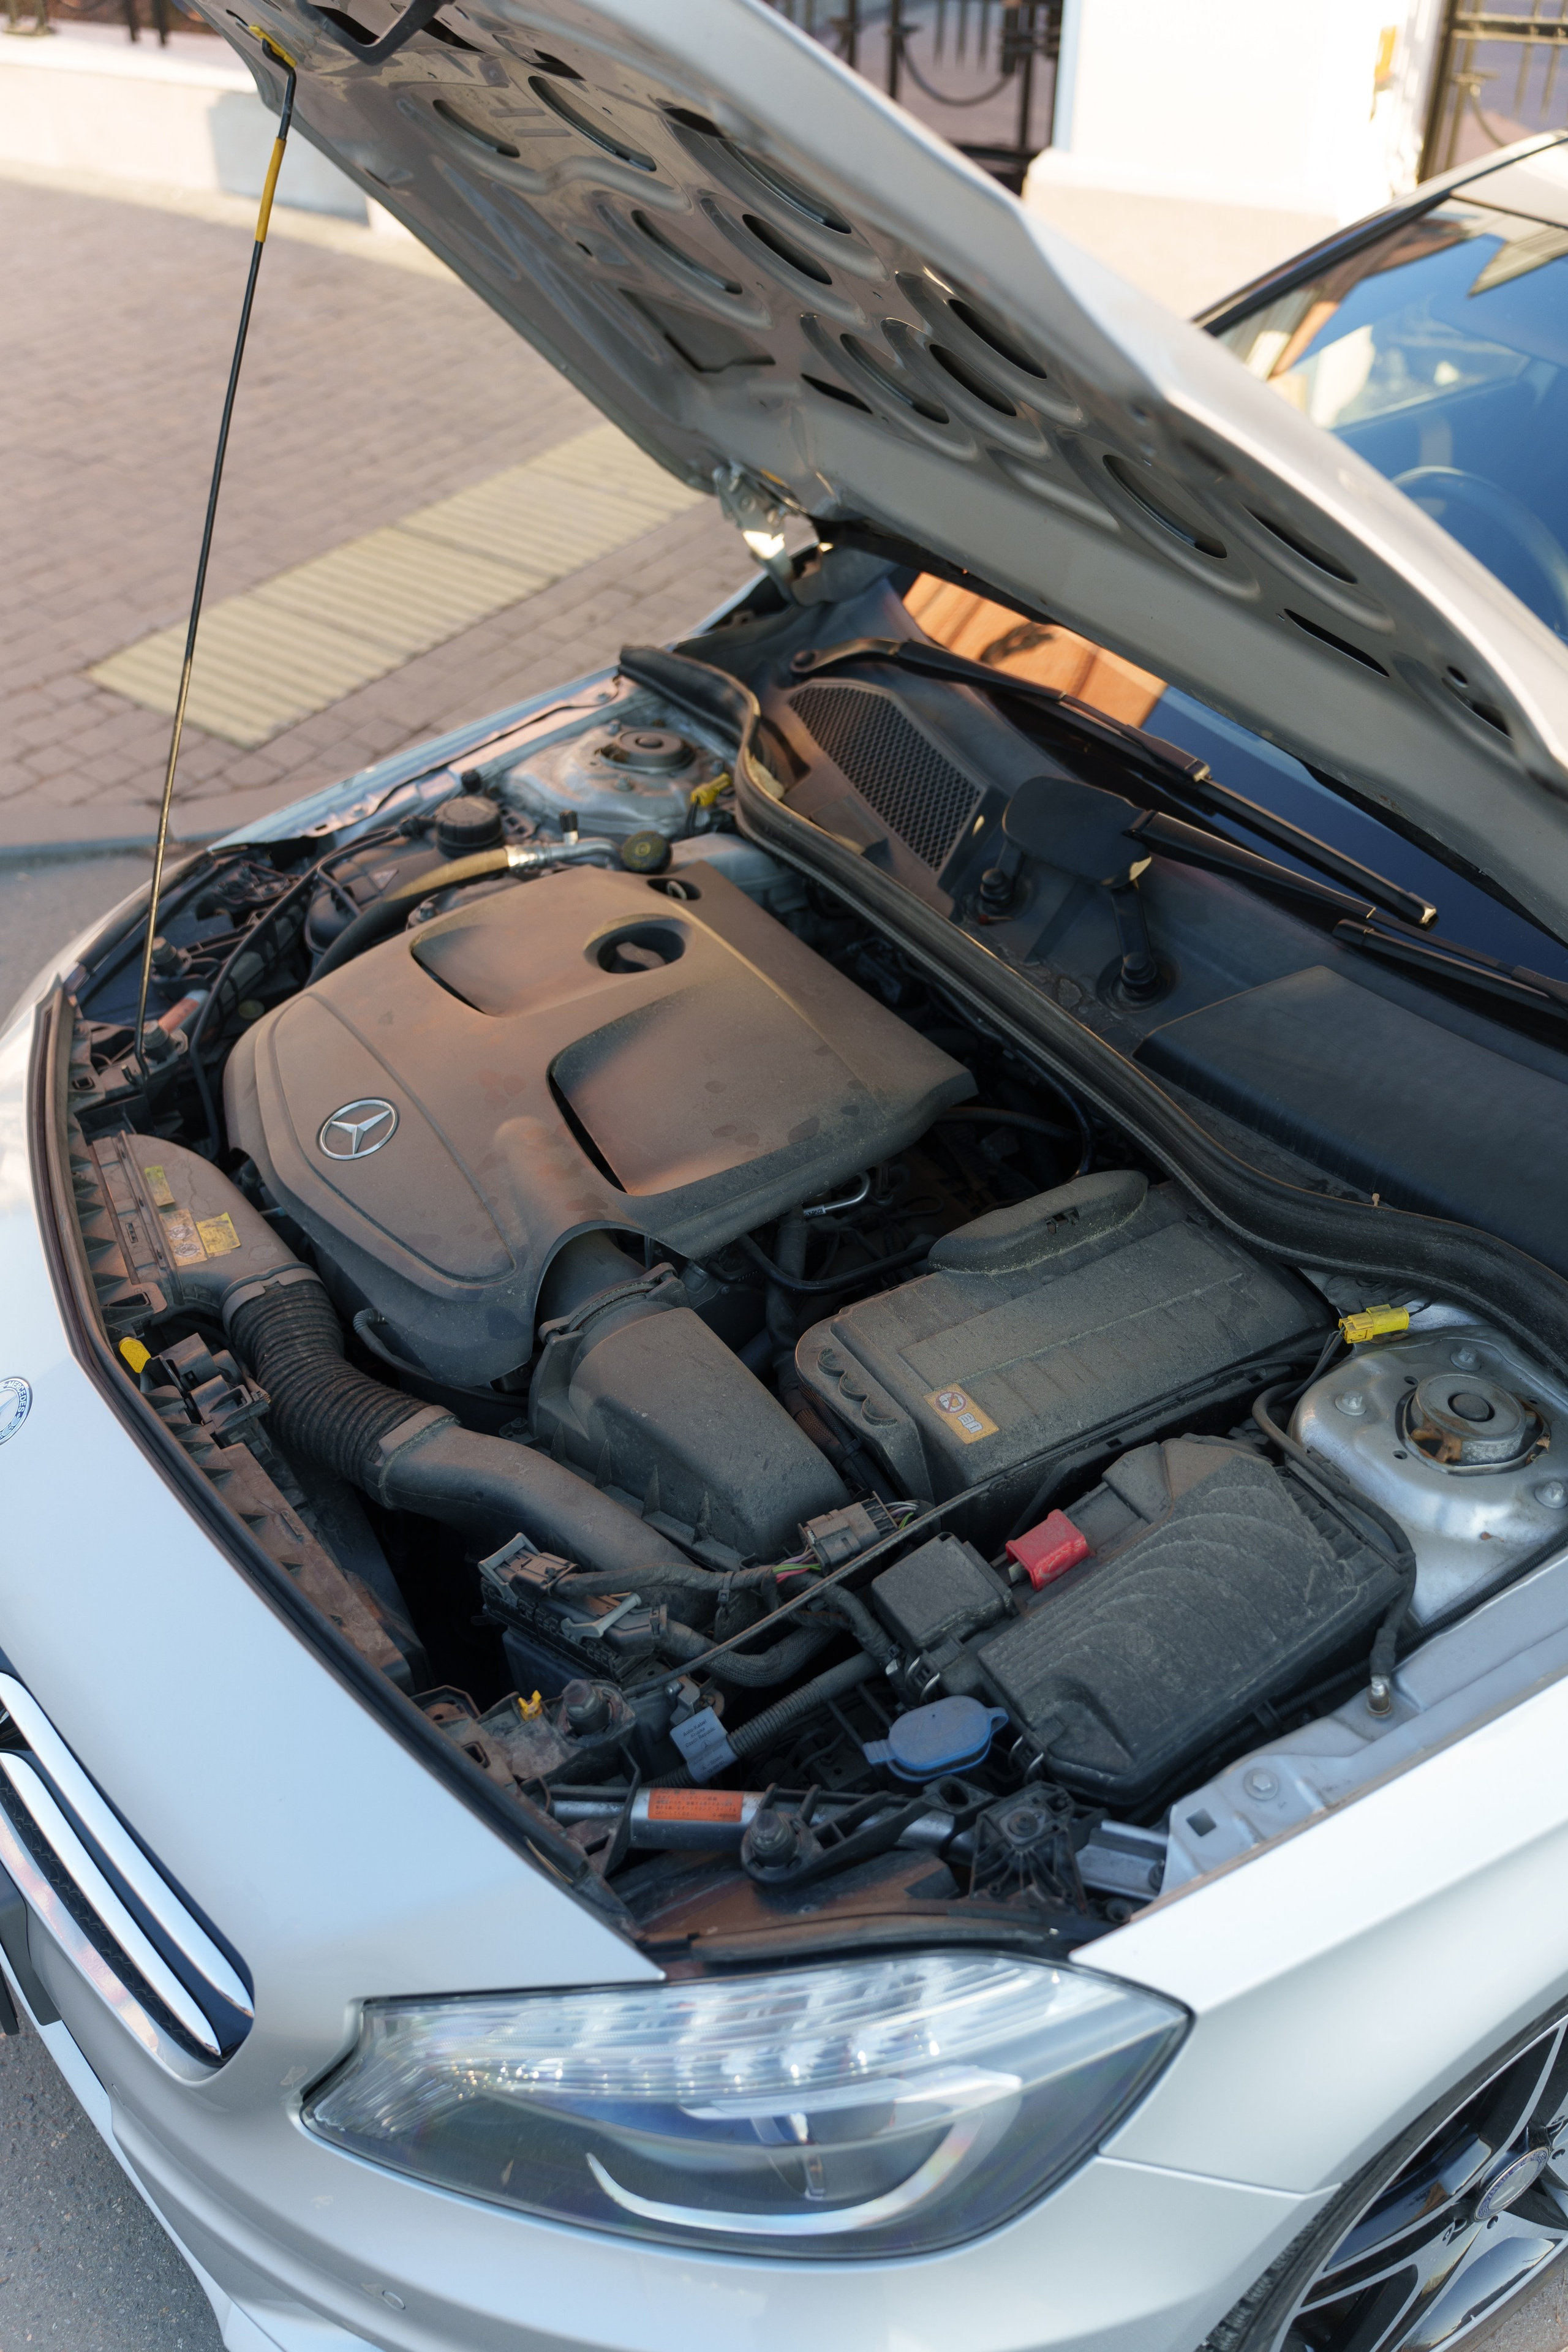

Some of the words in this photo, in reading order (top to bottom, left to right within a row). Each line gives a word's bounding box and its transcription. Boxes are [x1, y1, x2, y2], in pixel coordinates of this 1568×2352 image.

[6, 1381, 26, 1412] MERCEDES
[683, 1719, 707, 1736] Auto-Kabel
[698, 1727, 716, 1740] Republic
